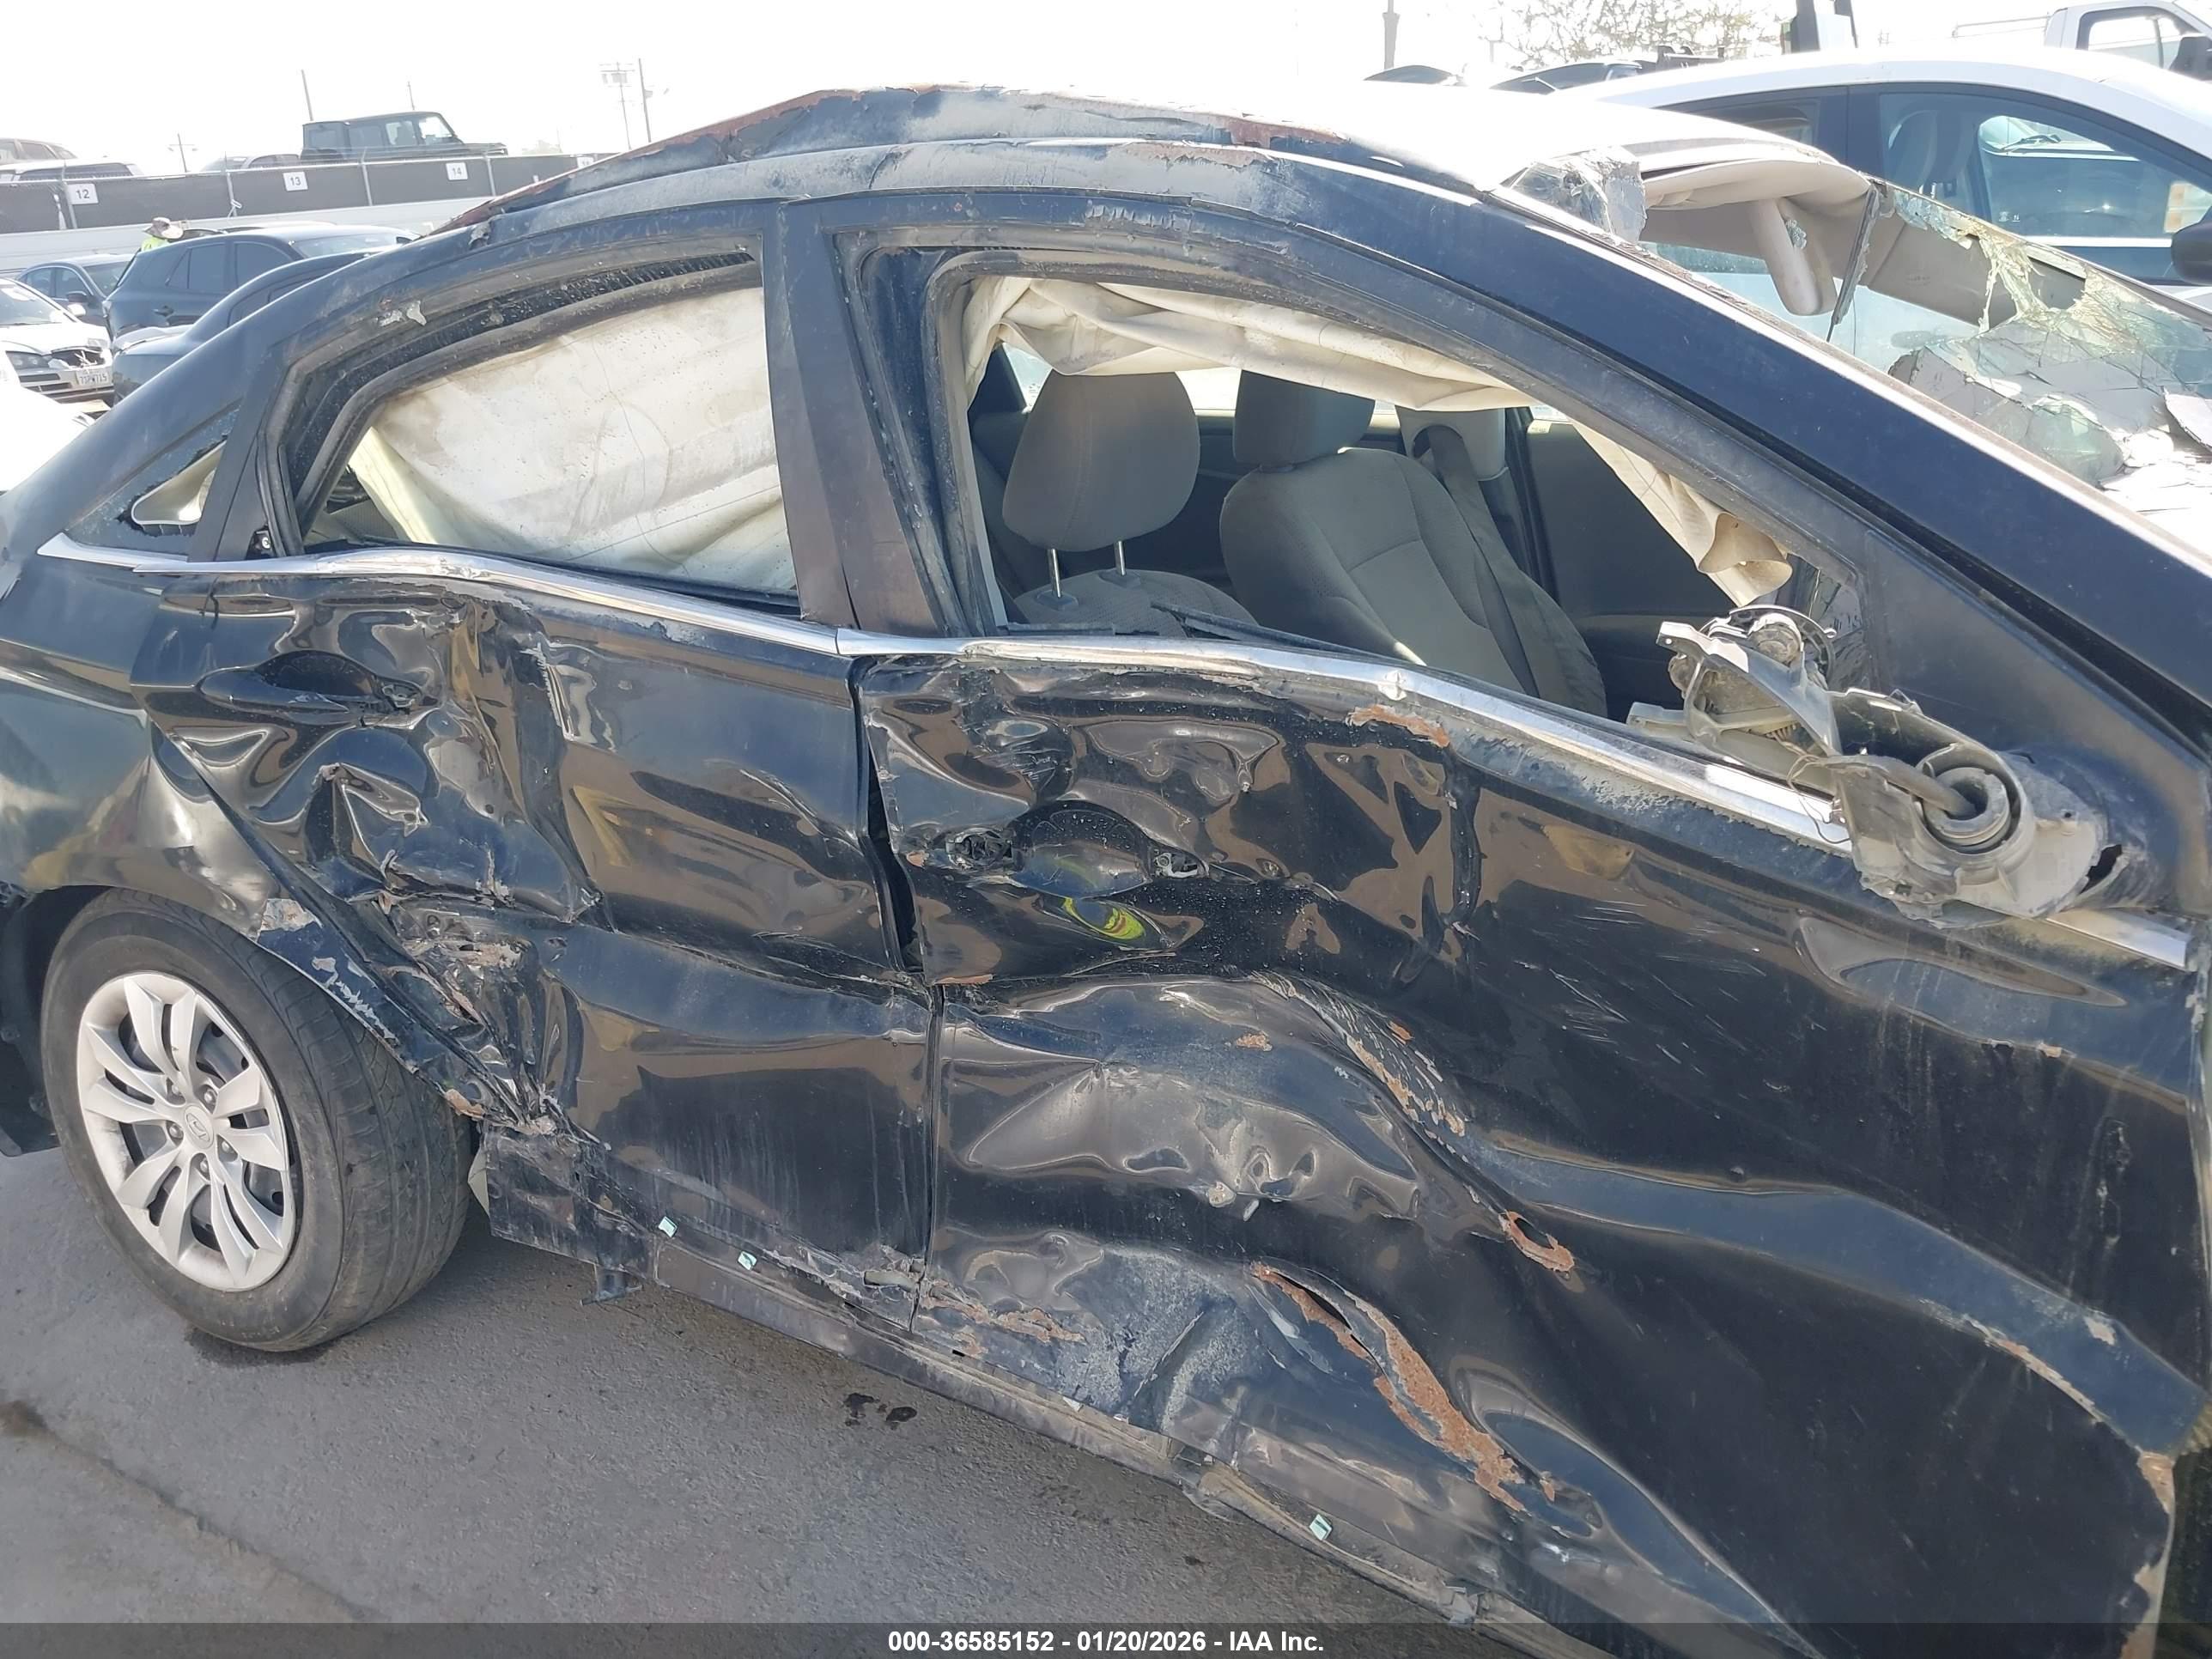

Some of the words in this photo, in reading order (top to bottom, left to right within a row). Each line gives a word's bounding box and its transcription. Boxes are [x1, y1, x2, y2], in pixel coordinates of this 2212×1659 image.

[452, 167, 462, 176] 14
[290, 176, 301, 186] 13
[76, 189, 89, 199] 12
